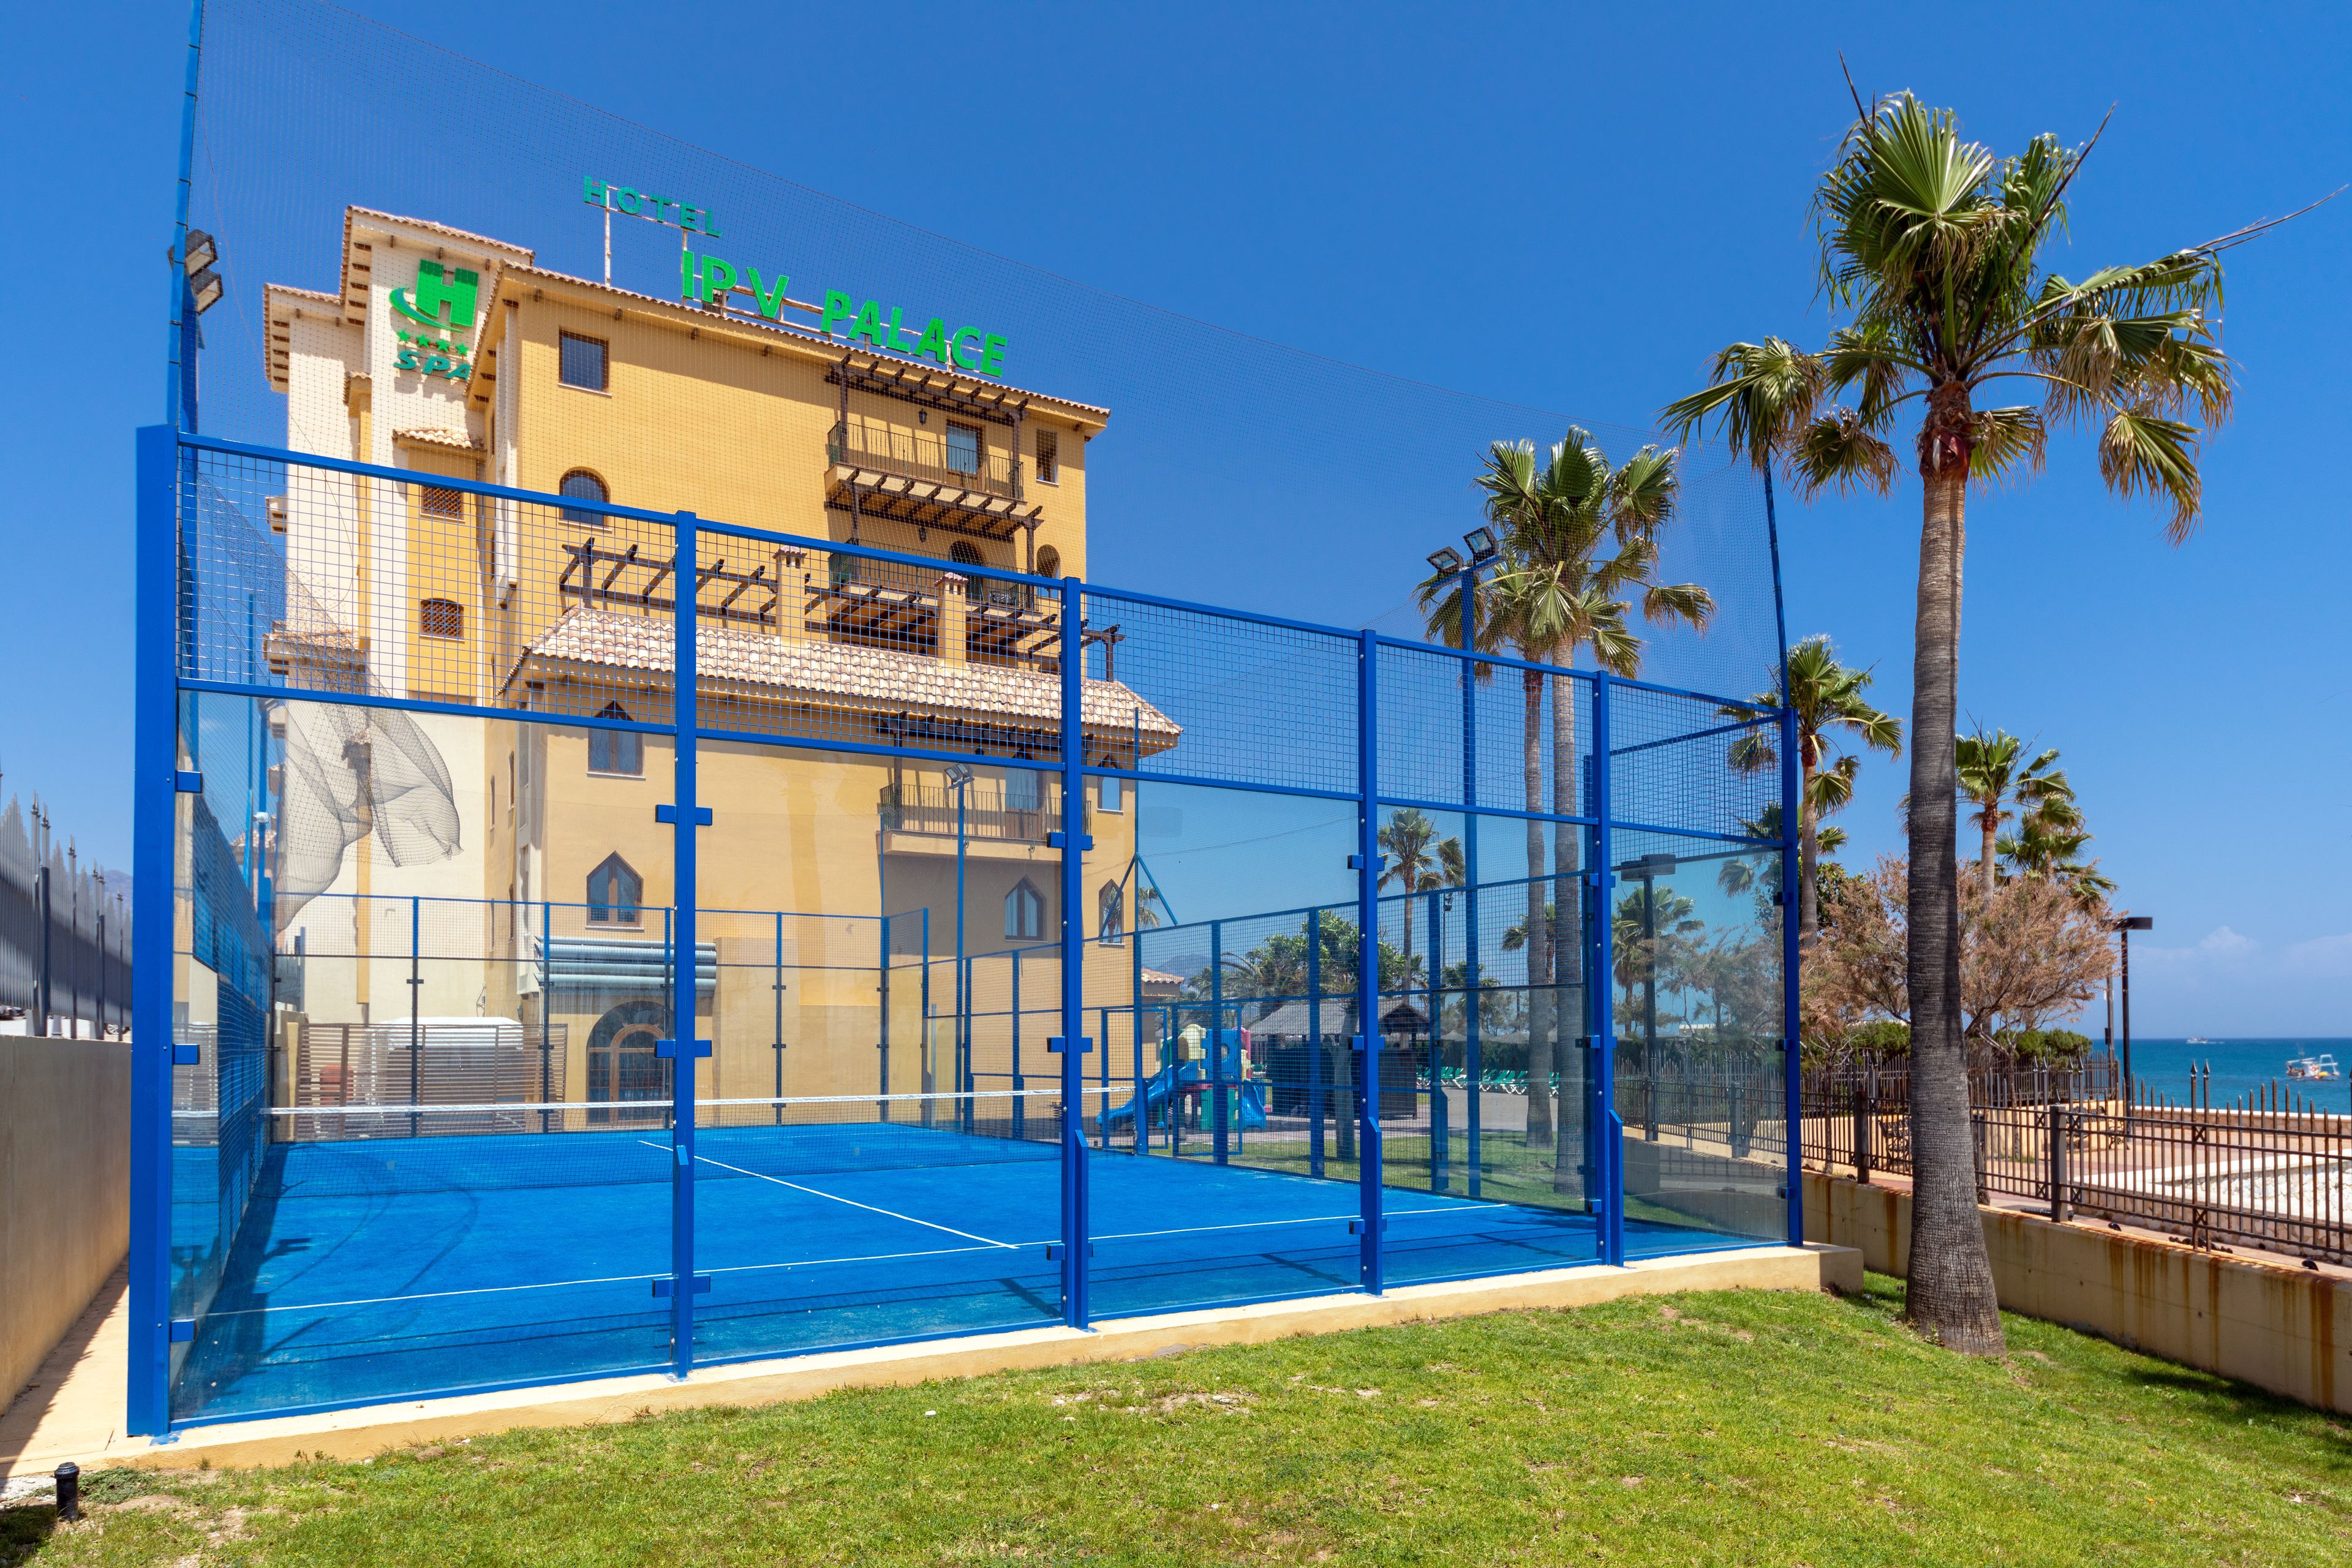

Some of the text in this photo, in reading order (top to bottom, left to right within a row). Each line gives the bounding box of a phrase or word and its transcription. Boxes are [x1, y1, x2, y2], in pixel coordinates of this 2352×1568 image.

[584, 176, 722, 238] HOTEL
[820, 289, 1008, 377] PALACE
[393, 350, 471, 380] SPA
